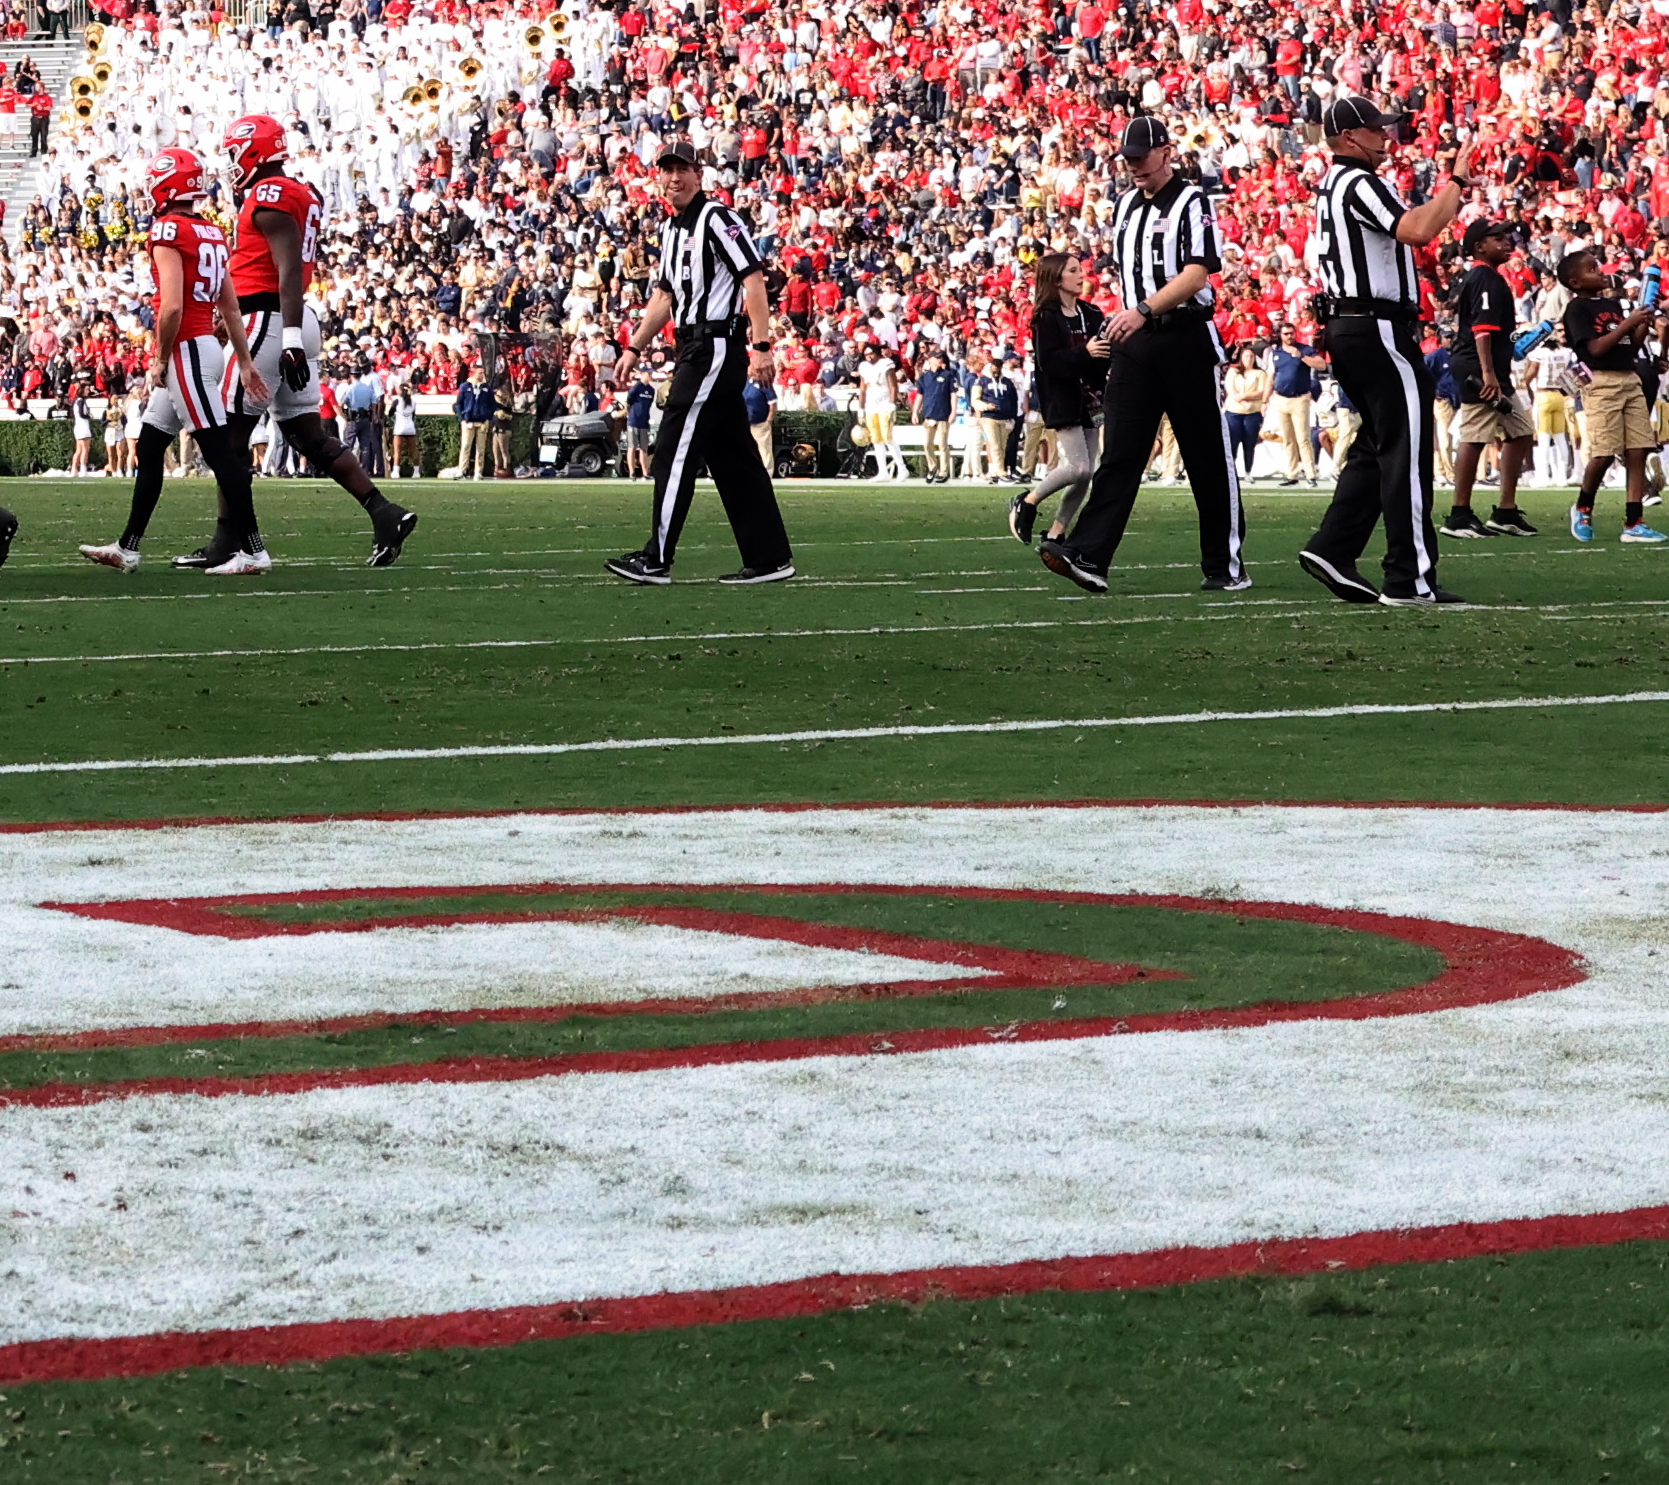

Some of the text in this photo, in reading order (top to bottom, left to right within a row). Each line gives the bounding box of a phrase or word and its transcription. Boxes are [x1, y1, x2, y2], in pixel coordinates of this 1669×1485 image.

[256, 184, 283, 203] 65
[151, 221, 178, 242] 96
[1152, 249, 1163, 265] L
[194, 244, 229, 302] 96
[682, 265, 691, 280] B
[1481, 291, 1490, 310] 1
